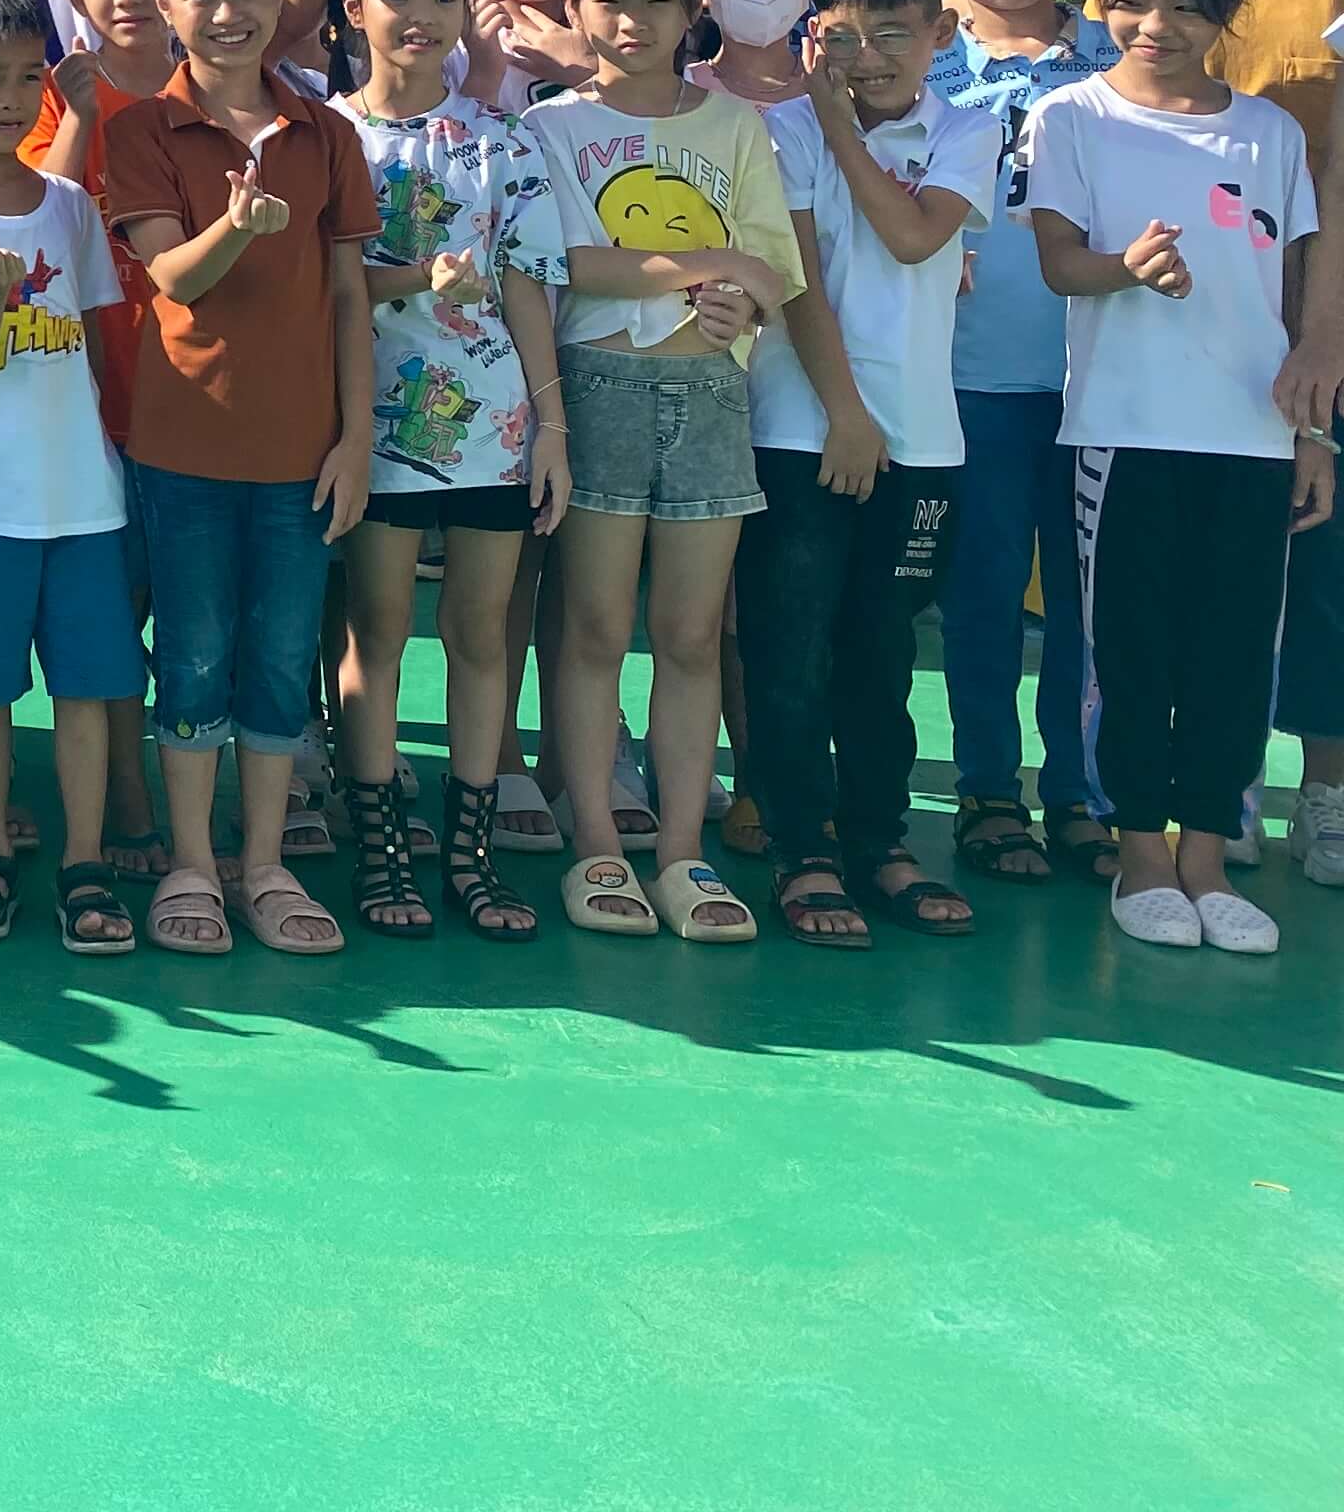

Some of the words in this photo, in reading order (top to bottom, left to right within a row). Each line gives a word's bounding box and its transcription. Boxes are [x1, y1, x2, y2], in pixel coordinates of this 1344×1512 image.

[578, 135, 645, 183] IVE
[656, 145, 732, 212] LIFE
[913, 499, 948, 530] NY
